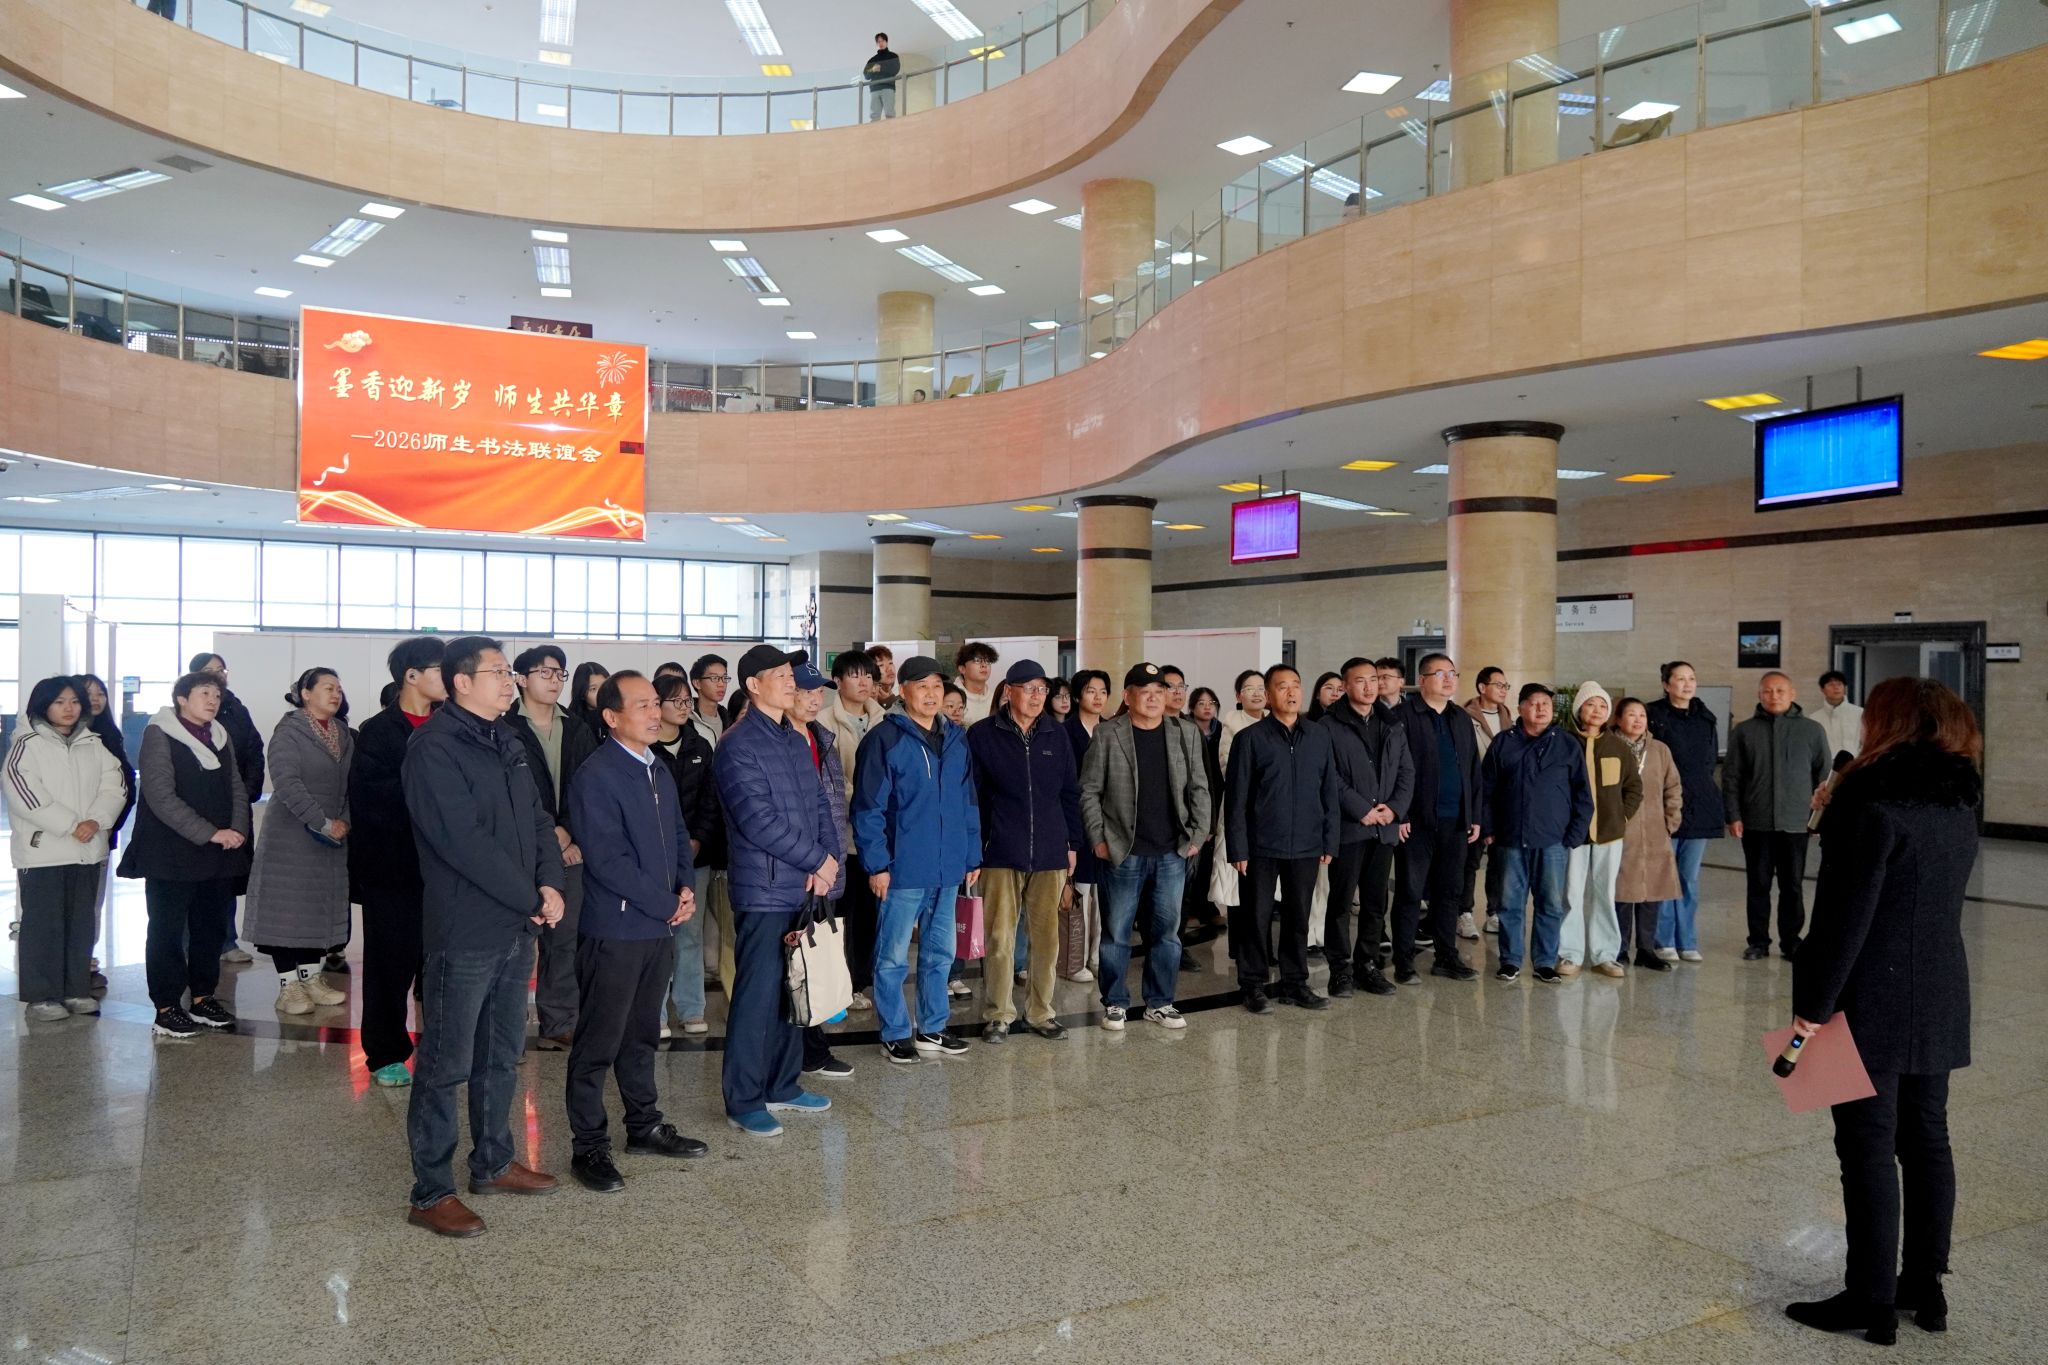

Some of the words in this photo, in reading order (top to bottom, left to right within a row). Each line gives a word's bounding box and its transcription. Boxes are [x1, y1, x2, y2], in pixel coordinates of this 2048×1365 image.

[329, 367, 472, 410] 墨香迎新岁
[494, 383, 626, 424] 师生共华章
